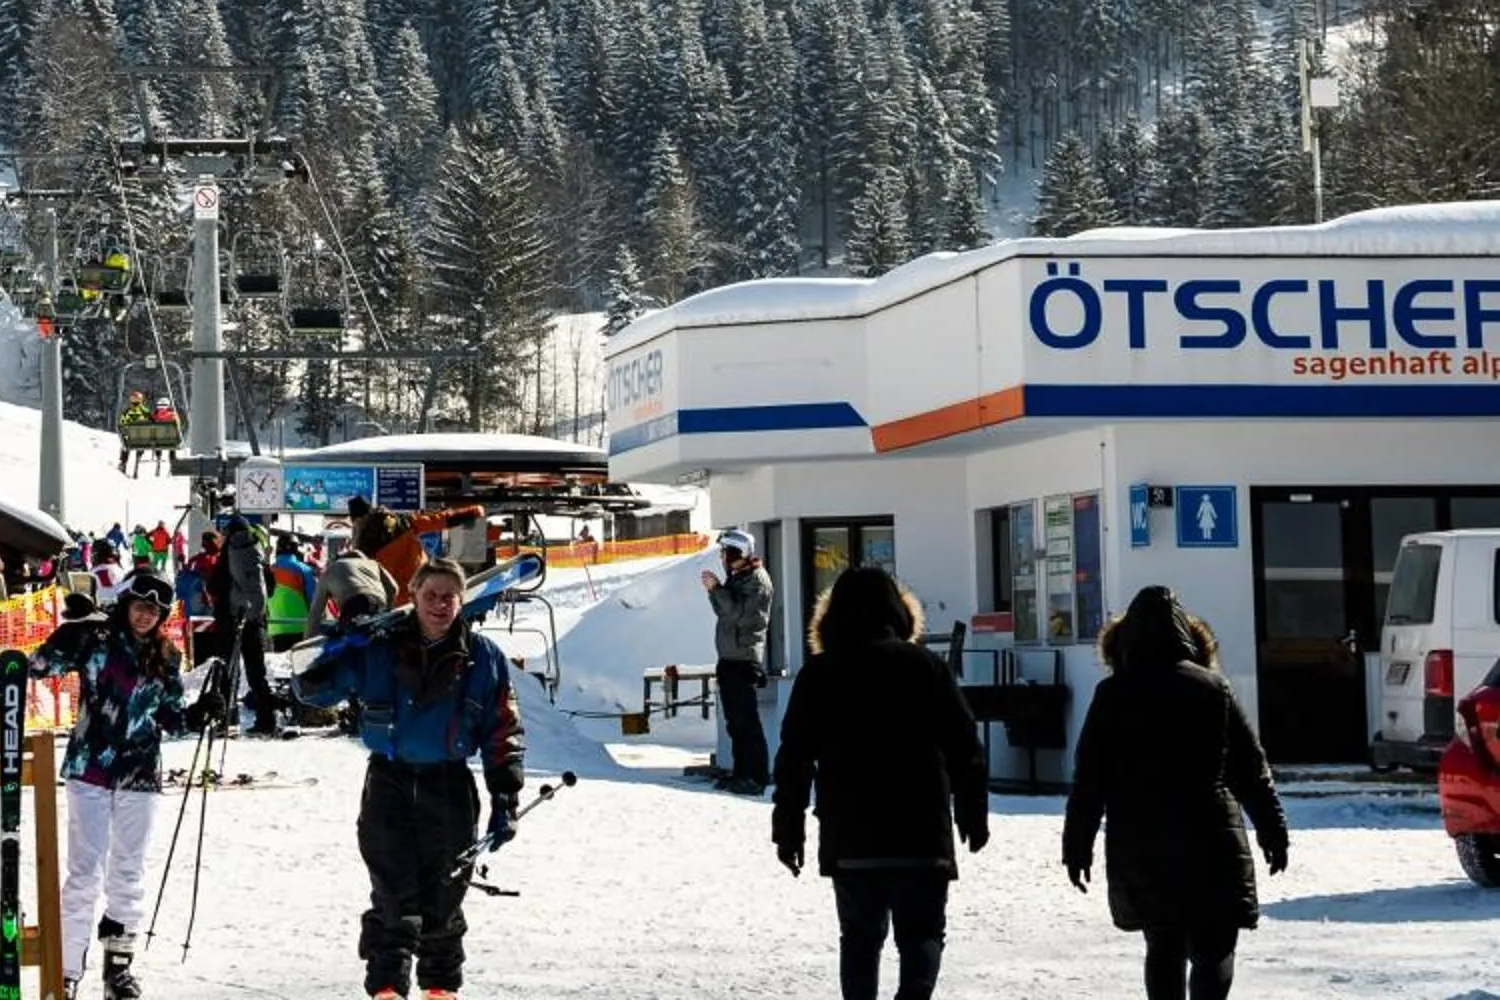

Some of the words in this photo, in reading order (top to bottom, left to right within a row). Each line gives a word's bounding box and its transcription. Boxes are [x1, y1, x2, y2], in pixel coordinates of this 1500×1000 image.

[1293, 350, 1453, 380] sagenhaft
[1131, 501, 1147, 529] WC
[4, 684, 19, 773] HEAD
